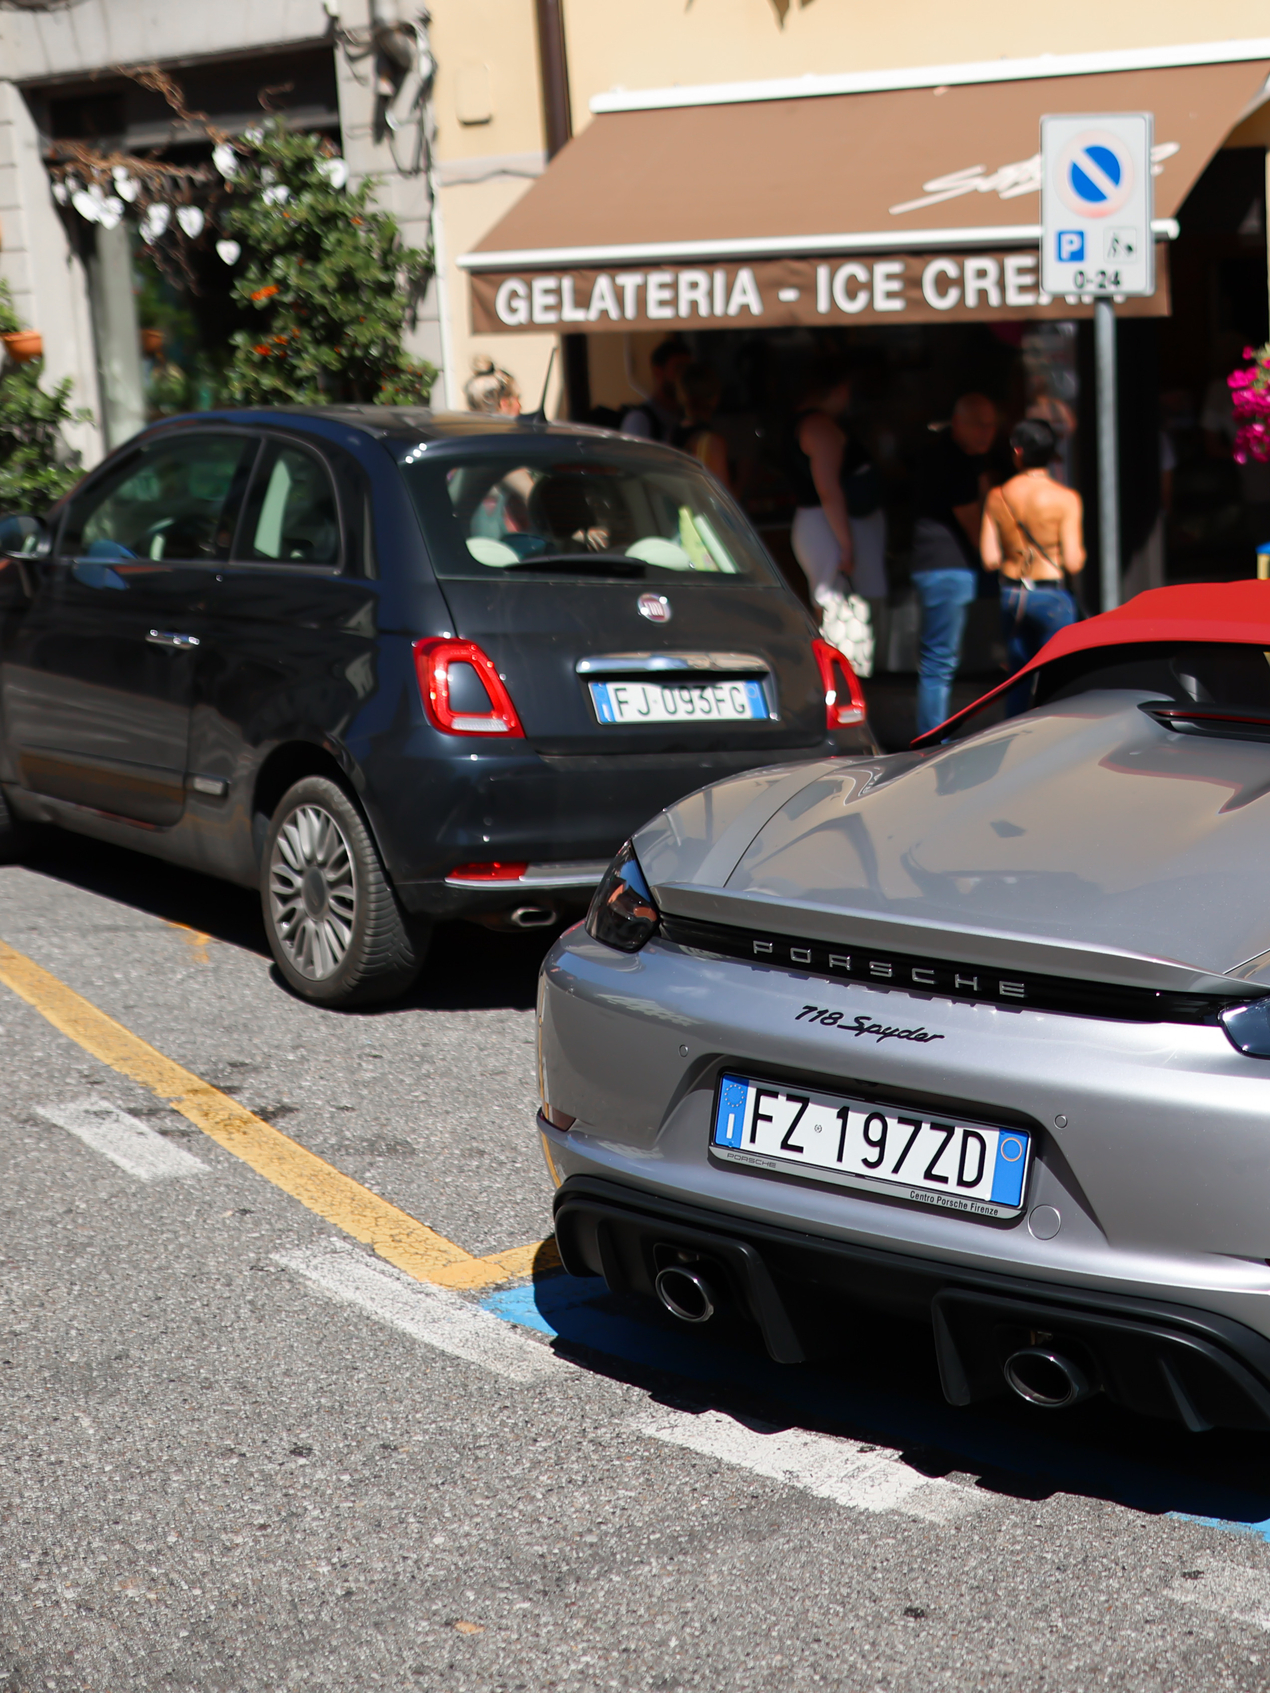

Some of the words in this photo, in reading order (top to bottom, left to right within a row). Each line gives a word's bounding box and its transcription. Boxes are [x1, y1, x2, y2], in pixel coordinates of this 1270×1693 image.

[1060, 232, 1083, 261] P
[495, 266, 764, 326] GELATERIA
[816, 261, 905, 314] ICE
[921, 255, 1127, 312] CRE
[1074, 270, 1121, 289] 0-24
[753, 939, 1025, 998] PORSCHE
[795, 1005, 844, 1026] 718
[837, 1016, 945, 1043] Spyder
[749, 1087, 810, 1154] FZ
[836, 1105, 987, 1189] 197ZD
[726, 1152, 777, 1169] PORSCHE
[910, 1190, 935, 1203] Centro
[936, 1195, 968, 1210] Porsche
[970, 1202, 999, 1217] Firenze
